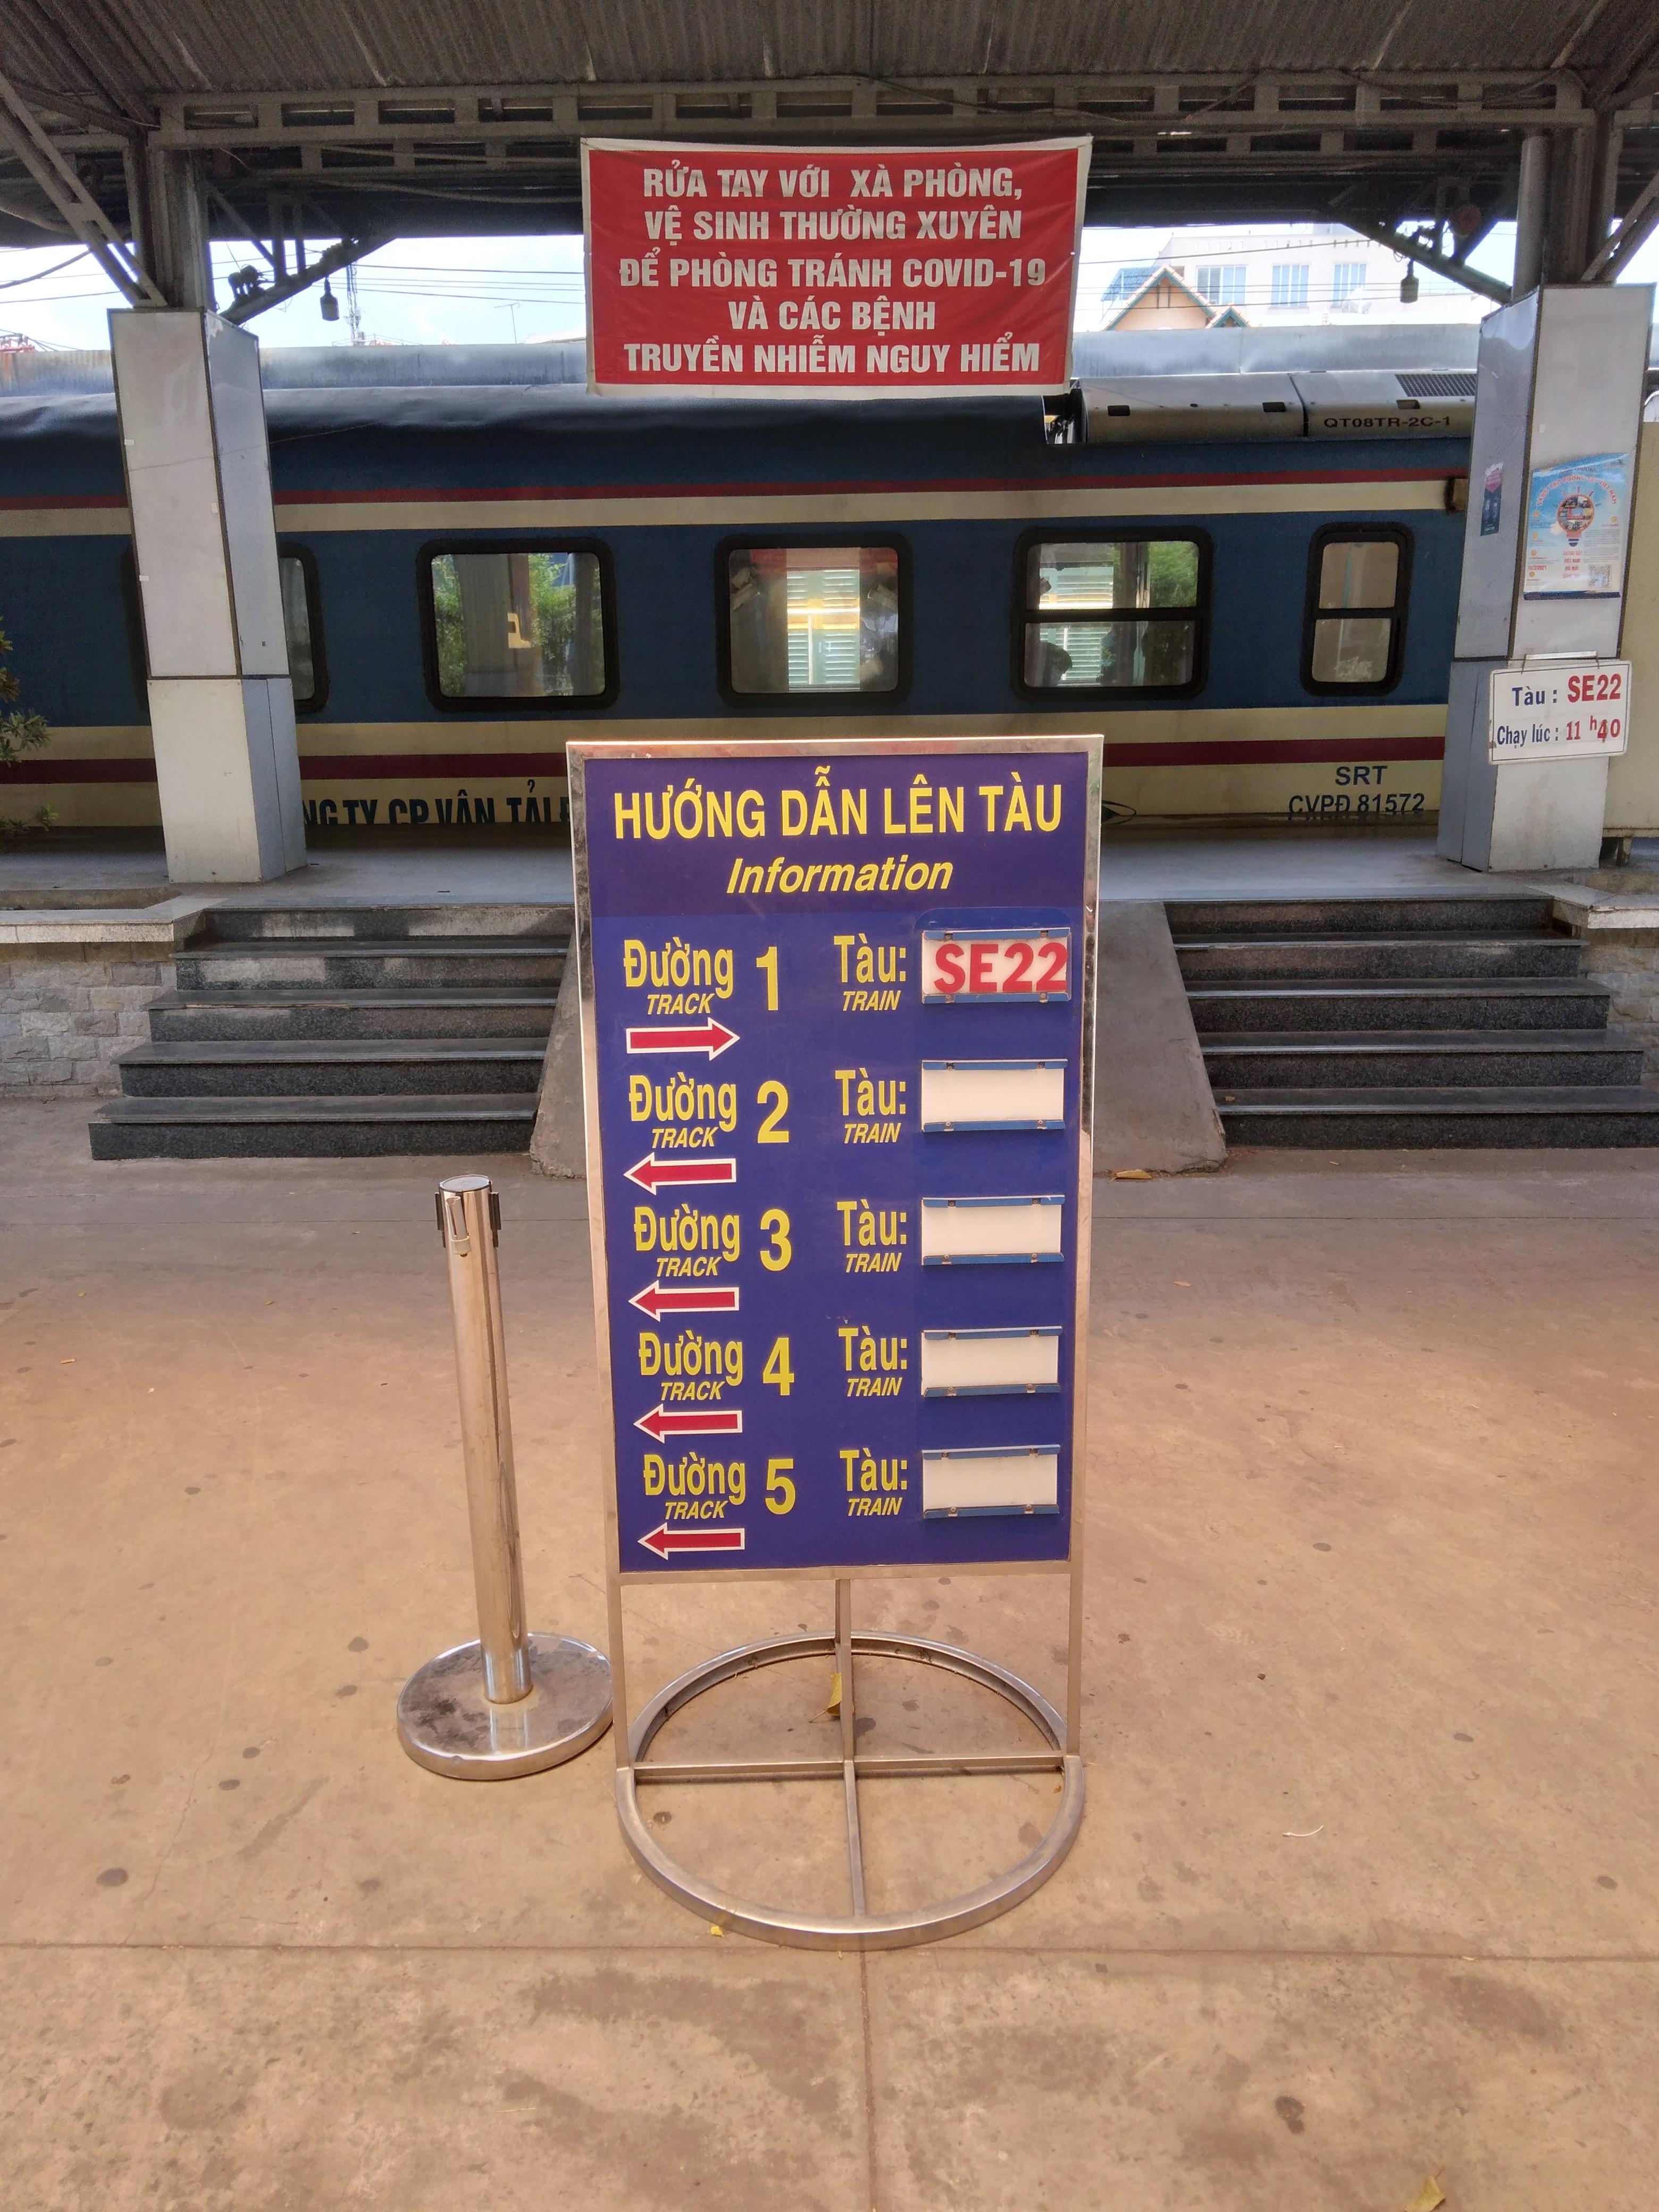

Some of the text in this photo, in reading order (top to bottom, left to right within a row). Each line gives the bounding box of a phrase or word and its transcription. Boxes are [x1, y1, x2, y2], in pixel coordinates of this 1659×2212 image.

[643, 159, 1022, 200] RỬA TAY VỚI XÀ PHÒNG,
[644, 204, 1021, 246] VỆ SINH THƯỜNG XUYÊN
[619, 247, 1045, 288] ĐỂ PHÒNG TRÁNH COVID-19
[728, 295, 935, 337] VÀ CÁC BỆNH
[624, 331, 1040, 373] TRUYỀN NHIỄM NGUY HIỂM
[1323, 416, 1450, 428] QT08TR-2C-1
[1512, 686, 1545, 707] Tàu
[1567, 673, 1622, 703] SE22
[1497, 725, 1527, 748] Chạy
[1532, 723, 1551, 743] lúc
[1566, 720, 1581, 740] 11
[1335, 765, 1388, 786] SRT
[342, 799, 378, 825] TY
[614, 777, 765, 840] HƯỚNG
[781, 765, 867, 836] DẪN
[884, 773, 964, 834] LÊN
[978, 771, 1062, 832] TÀU
[1288, 792, 1425, 815] CVPĐ 81572
[726, 854, 953, 894] Information
[624, 933, 1068, 1011] Đường 1 Tàu: SE22
[646, 993, 715, 1015] TRACK
[842, 991, 901, 1011] TRAIN
[629, 1068, 906, 1143] Đường 2 Tàu:
[651, 1126, 718, 1148] TRACK
[843, 1122, 901, 1143] TRAIN
[633, 1199, 907, 1272] Đường 3 Tàu:
[656, 1256, 721, 1277] TRACK
[845, 1253, 902, 1273] TRAIN
[639, 1325, 907, 1396] Đường 4 Tàu:
[660, 1381, 724, 1401] TRACK
[847, 1377, 902, 1396] TRAIN
[643, 1448, 908, 1514] Đường 5 Tàu:
[664, 1500, 728, 1519] TRACK
[848, 1497, 902, 1515] TRAIN
